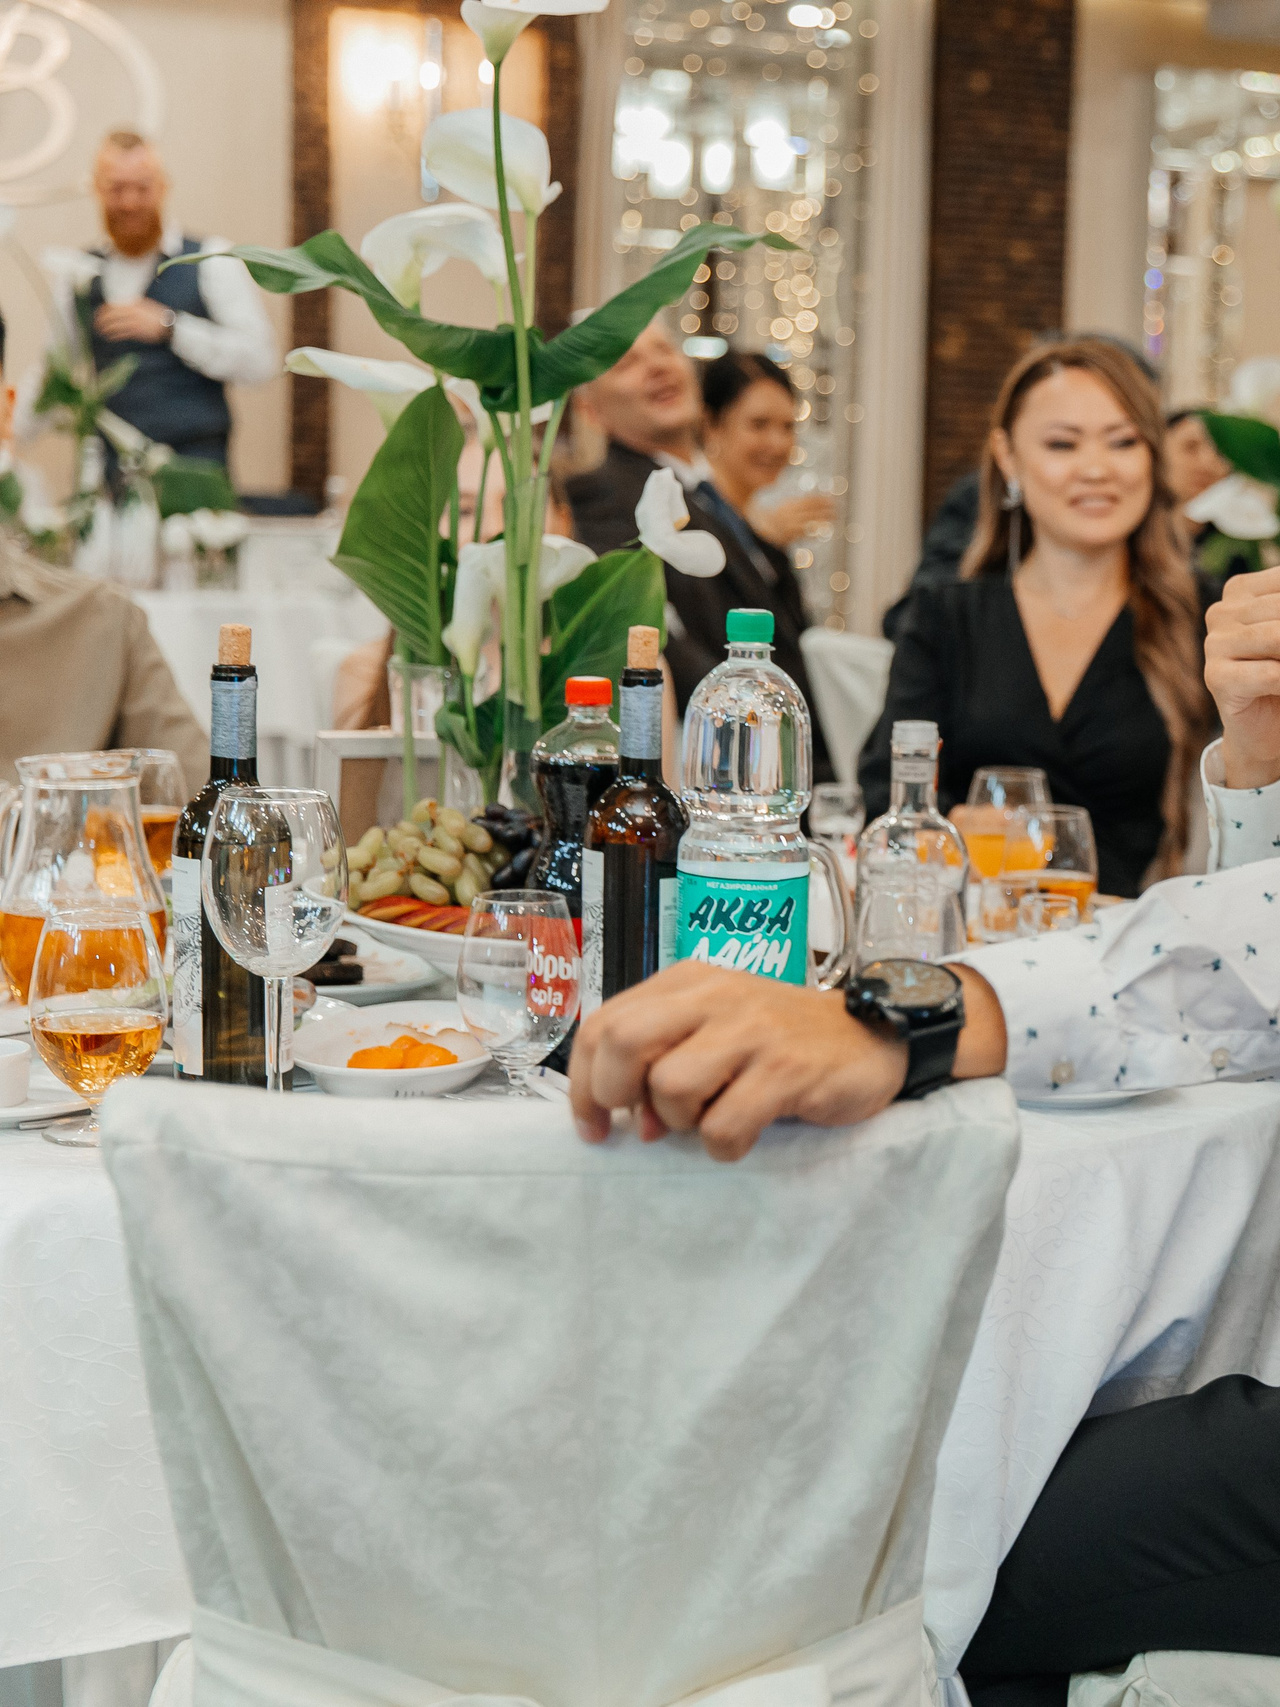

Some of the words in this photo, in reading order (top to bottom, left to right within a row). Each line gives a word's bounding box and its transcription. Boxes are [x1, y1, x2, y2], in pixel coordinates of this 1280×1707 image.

[688, 895, 796, 936] АКВА
[690, 933, 792, 978] ЛАЙН
[531, 986, 564, 1007] cola
